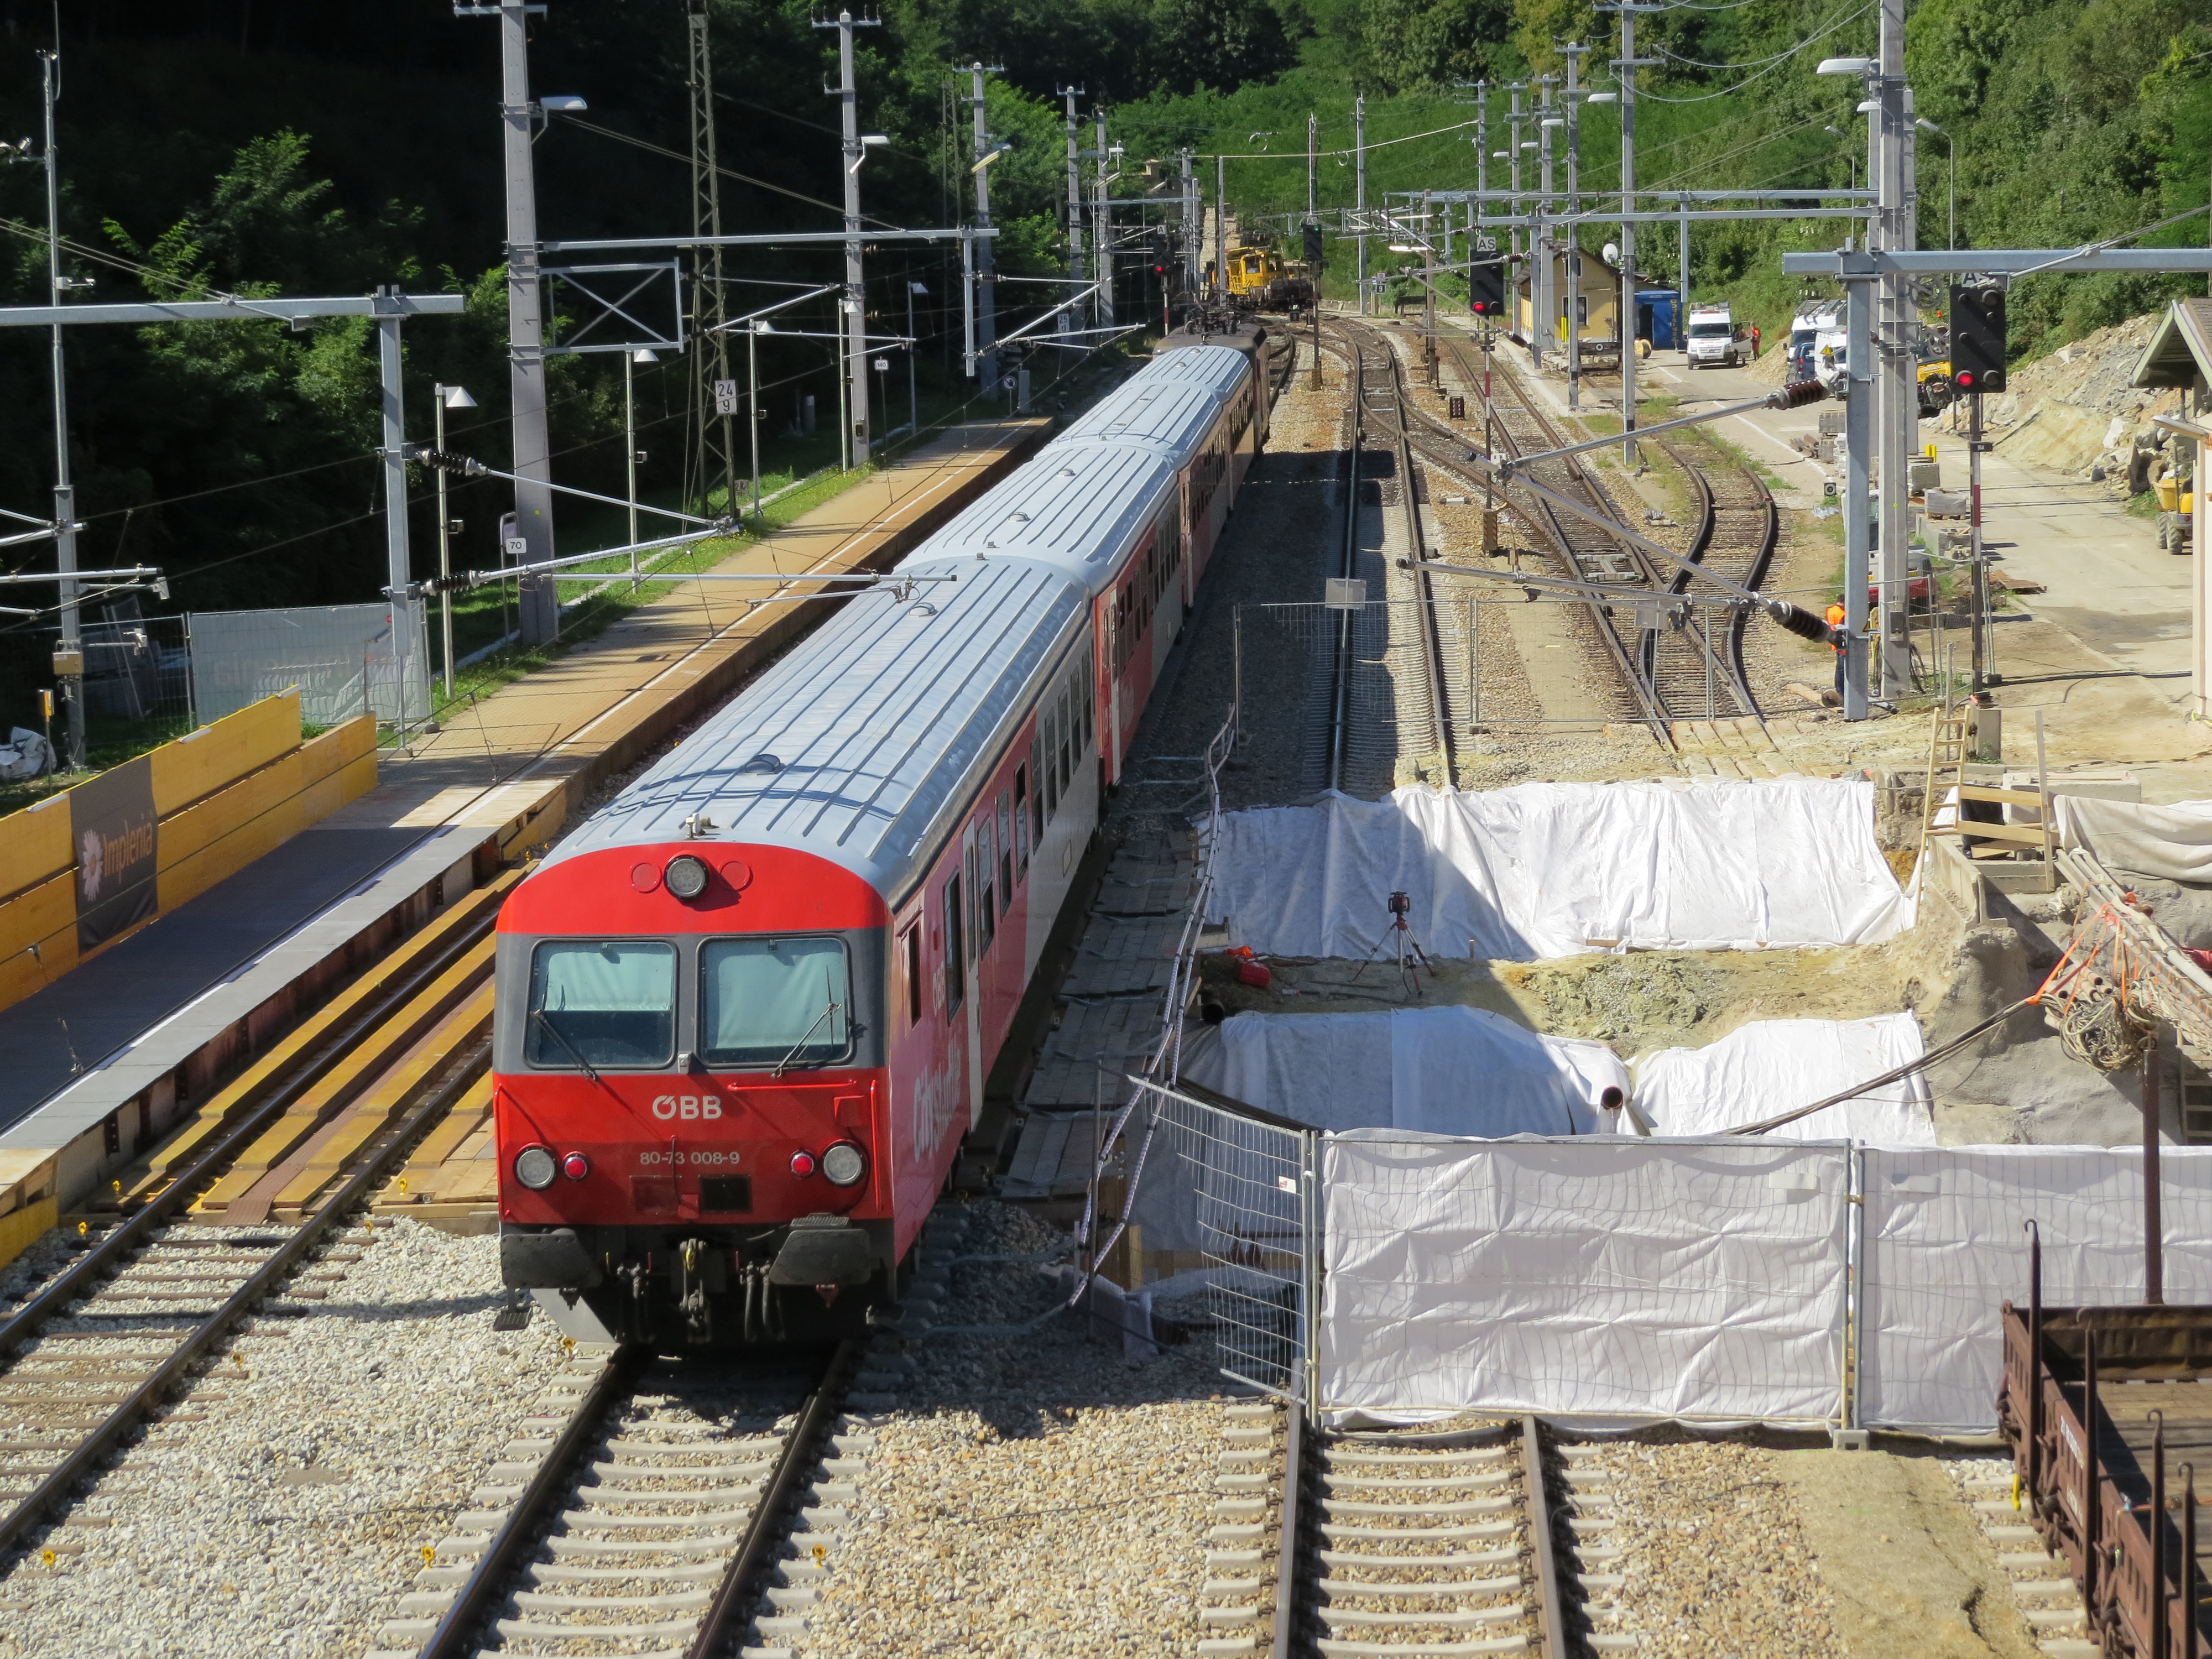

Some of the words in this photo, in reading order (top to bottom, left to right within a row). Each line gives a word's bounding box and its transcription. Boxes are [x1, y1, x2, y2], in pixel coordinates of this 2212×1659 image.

[1478, 239, 1495, 249] AS
[718, 383, 733, 397] 24
[723, 399, 730, 411] 9
[102, 813, 153, 884] Implenia
[652, 1095, 722, 1120] ÖBB
[640, 1151, 685, 1165] 80-73
[691, 1151, 740, 1165] 008-9
